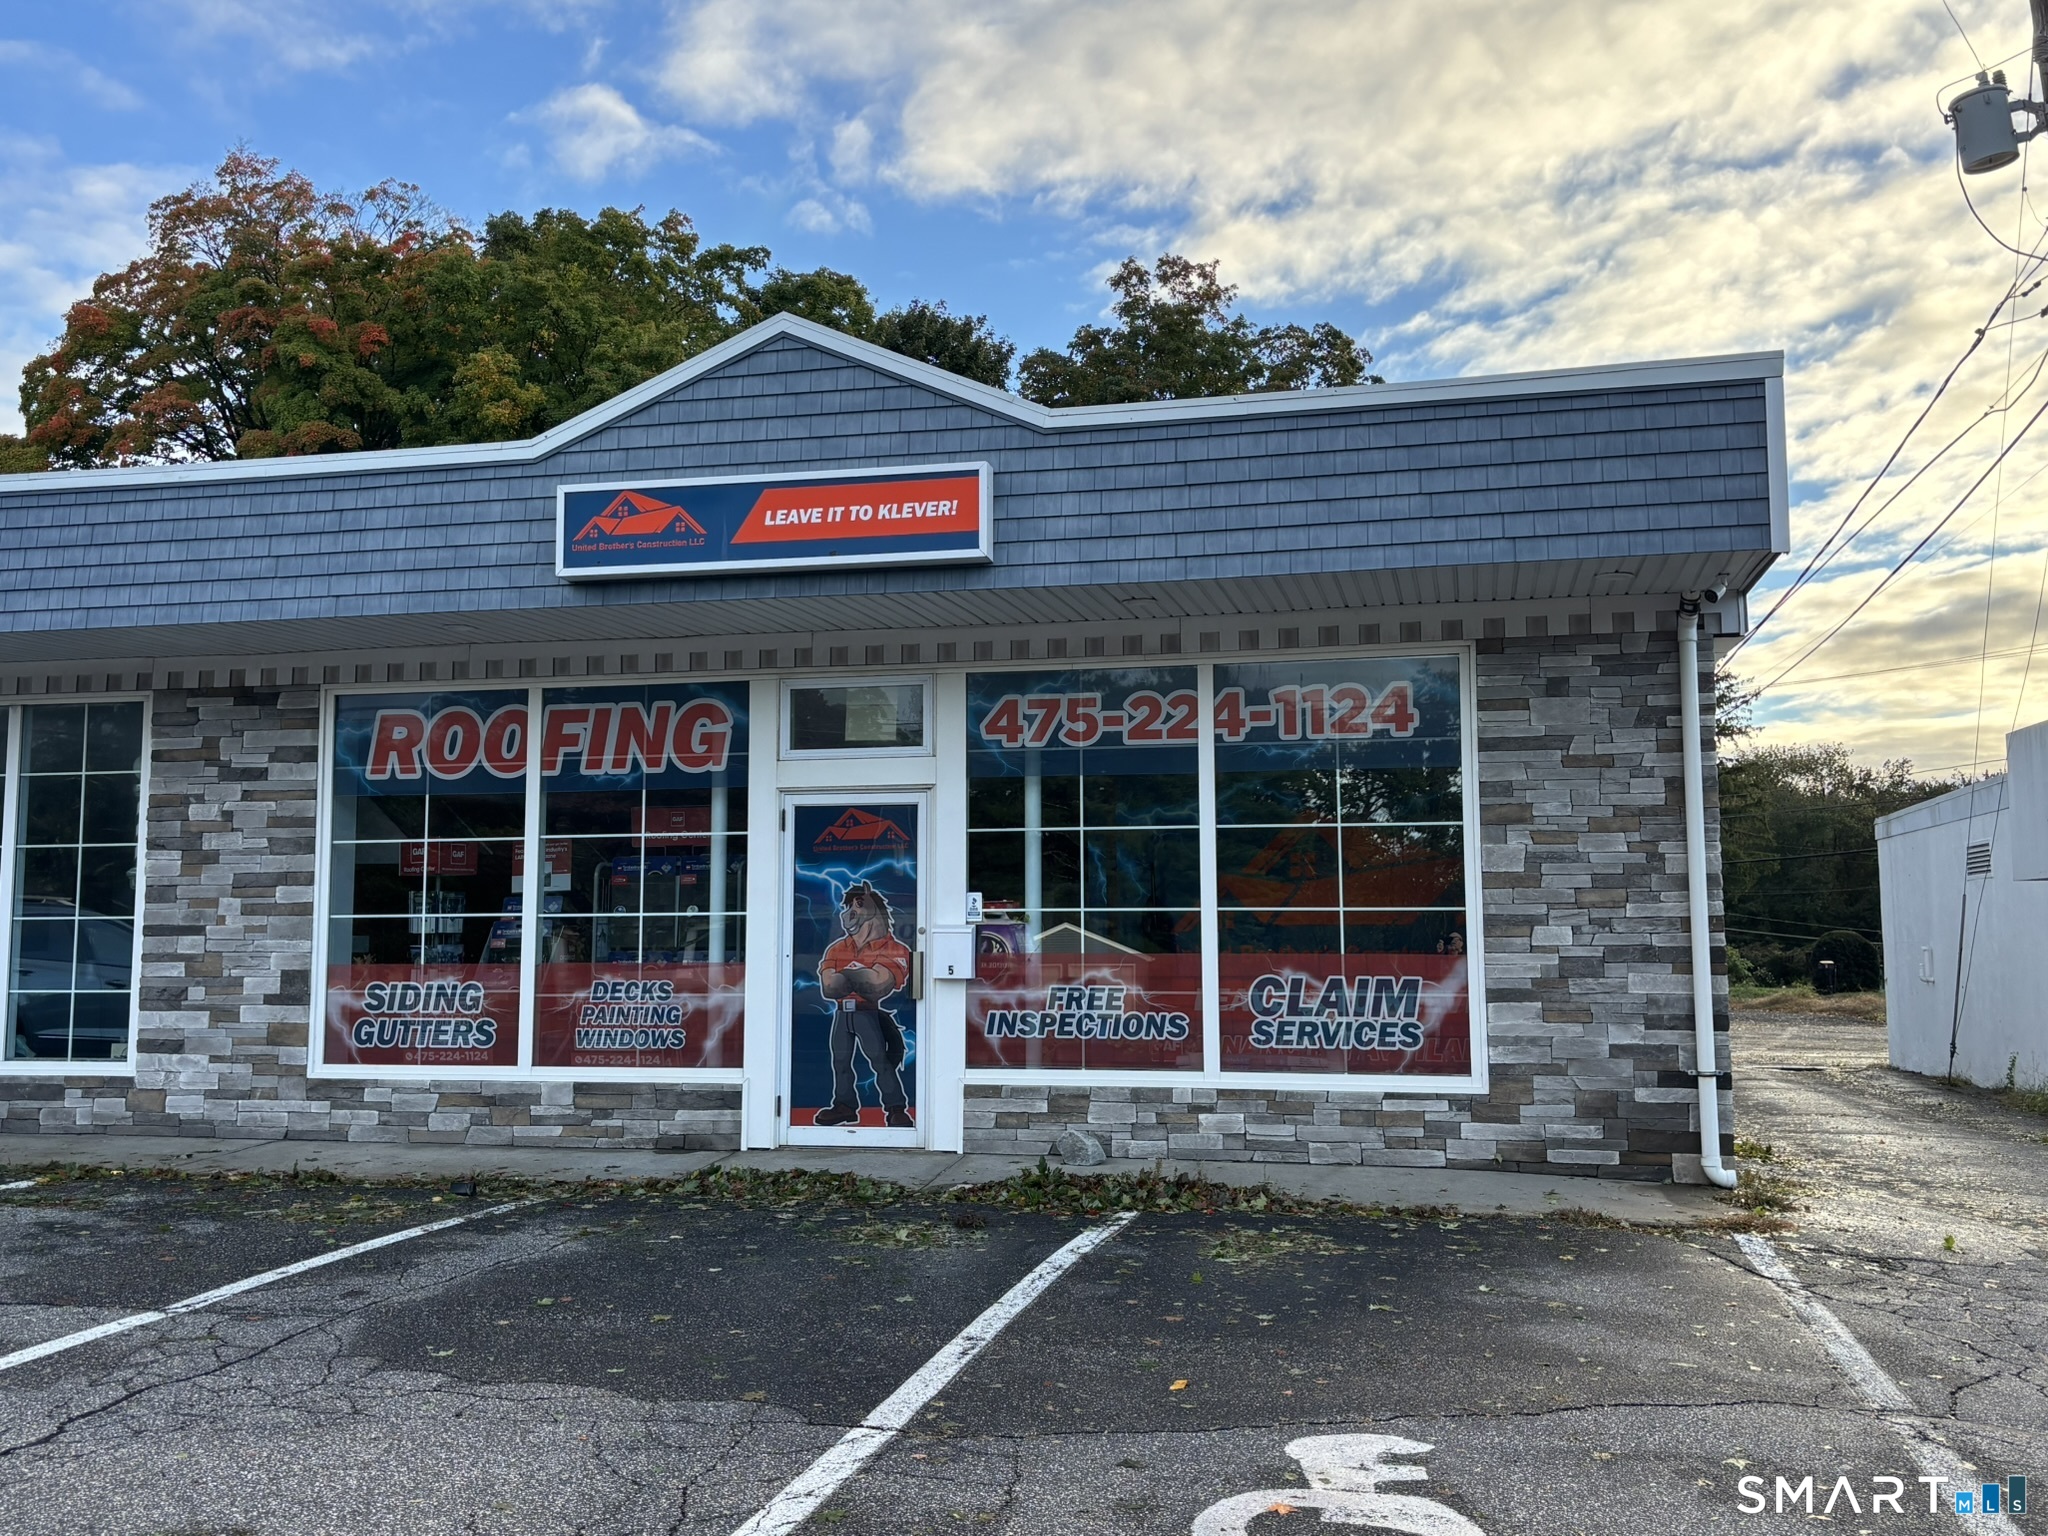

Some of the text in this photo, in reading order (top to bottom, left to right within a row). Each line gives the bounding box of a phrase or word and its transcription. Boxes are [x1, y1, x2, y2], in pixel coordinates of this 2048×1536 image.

[764, 499, 959, 526] LEAVE IT TO KLEVER!
[571, 538, 705, 552] United Brother's Construction LLC
[979, 680, 1419, 747] 475-224-1124
[365, 698, 734, 780] ROOFING
[948, 965, 954, 975] 5
[363, 981, 484, 1014] SIDING
[590, 980, 674, 1003] DECKS
[1047, 985, 1126, 1012] FREE
[1250, 974, 1422, 1020] CLAIM
[580, 1004, 682, 1025] PAINTING
[985, 1010, 1190, 1040] INSPECTIONS
[352, 1017, 498, 1048] GUTTERS
[576, 1027, 687, 1049] WINDOWS
[1250, 1018, 1424, 1050] SERVICES
